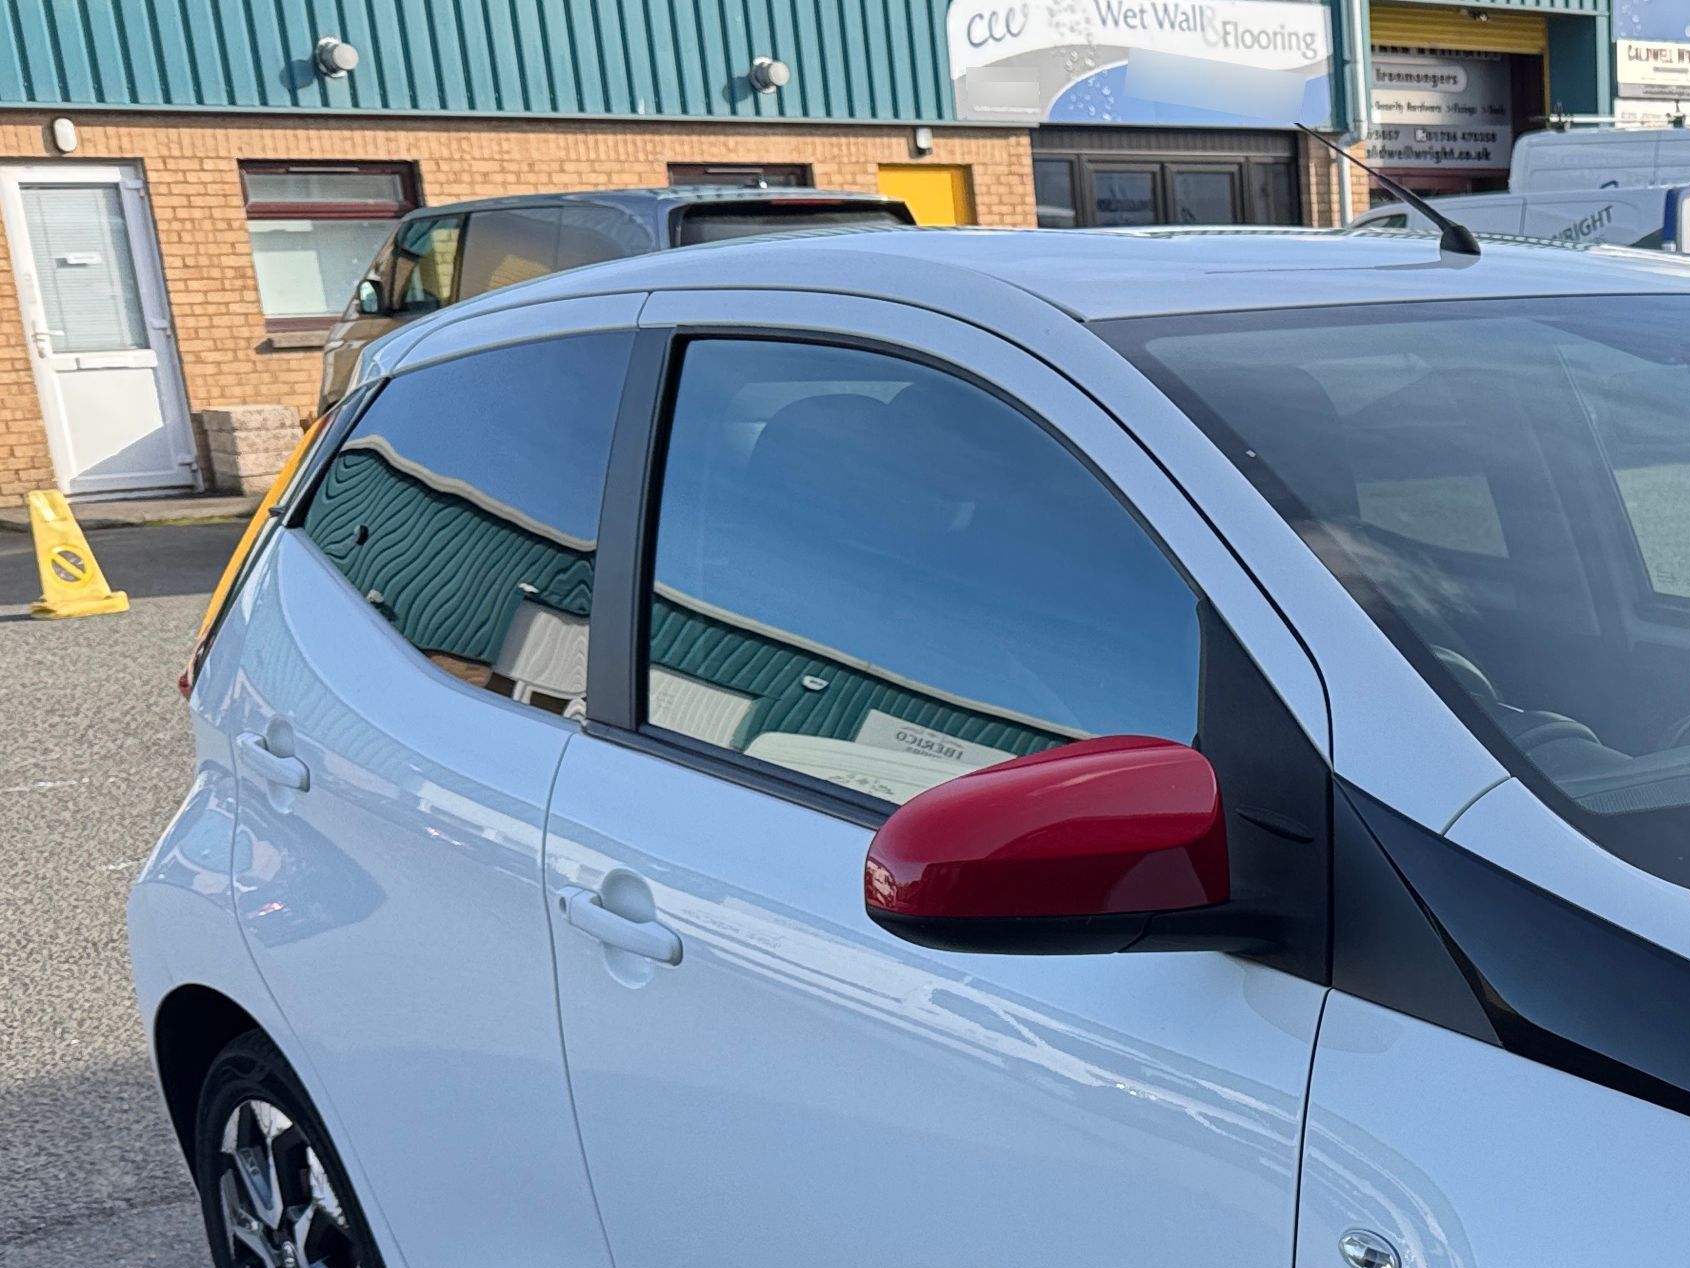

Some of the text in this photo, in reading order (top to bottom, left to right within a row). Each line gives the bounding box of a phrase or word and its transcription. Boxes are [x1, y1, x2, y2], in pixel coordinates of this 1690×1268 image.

[1095, 0, 1148, 30] Wet
[1151, 3, 1205, 33] Wall
[1221, 20, 1317, 60] Flooring
[1375, 69, 1458, 88] Ironmongers
